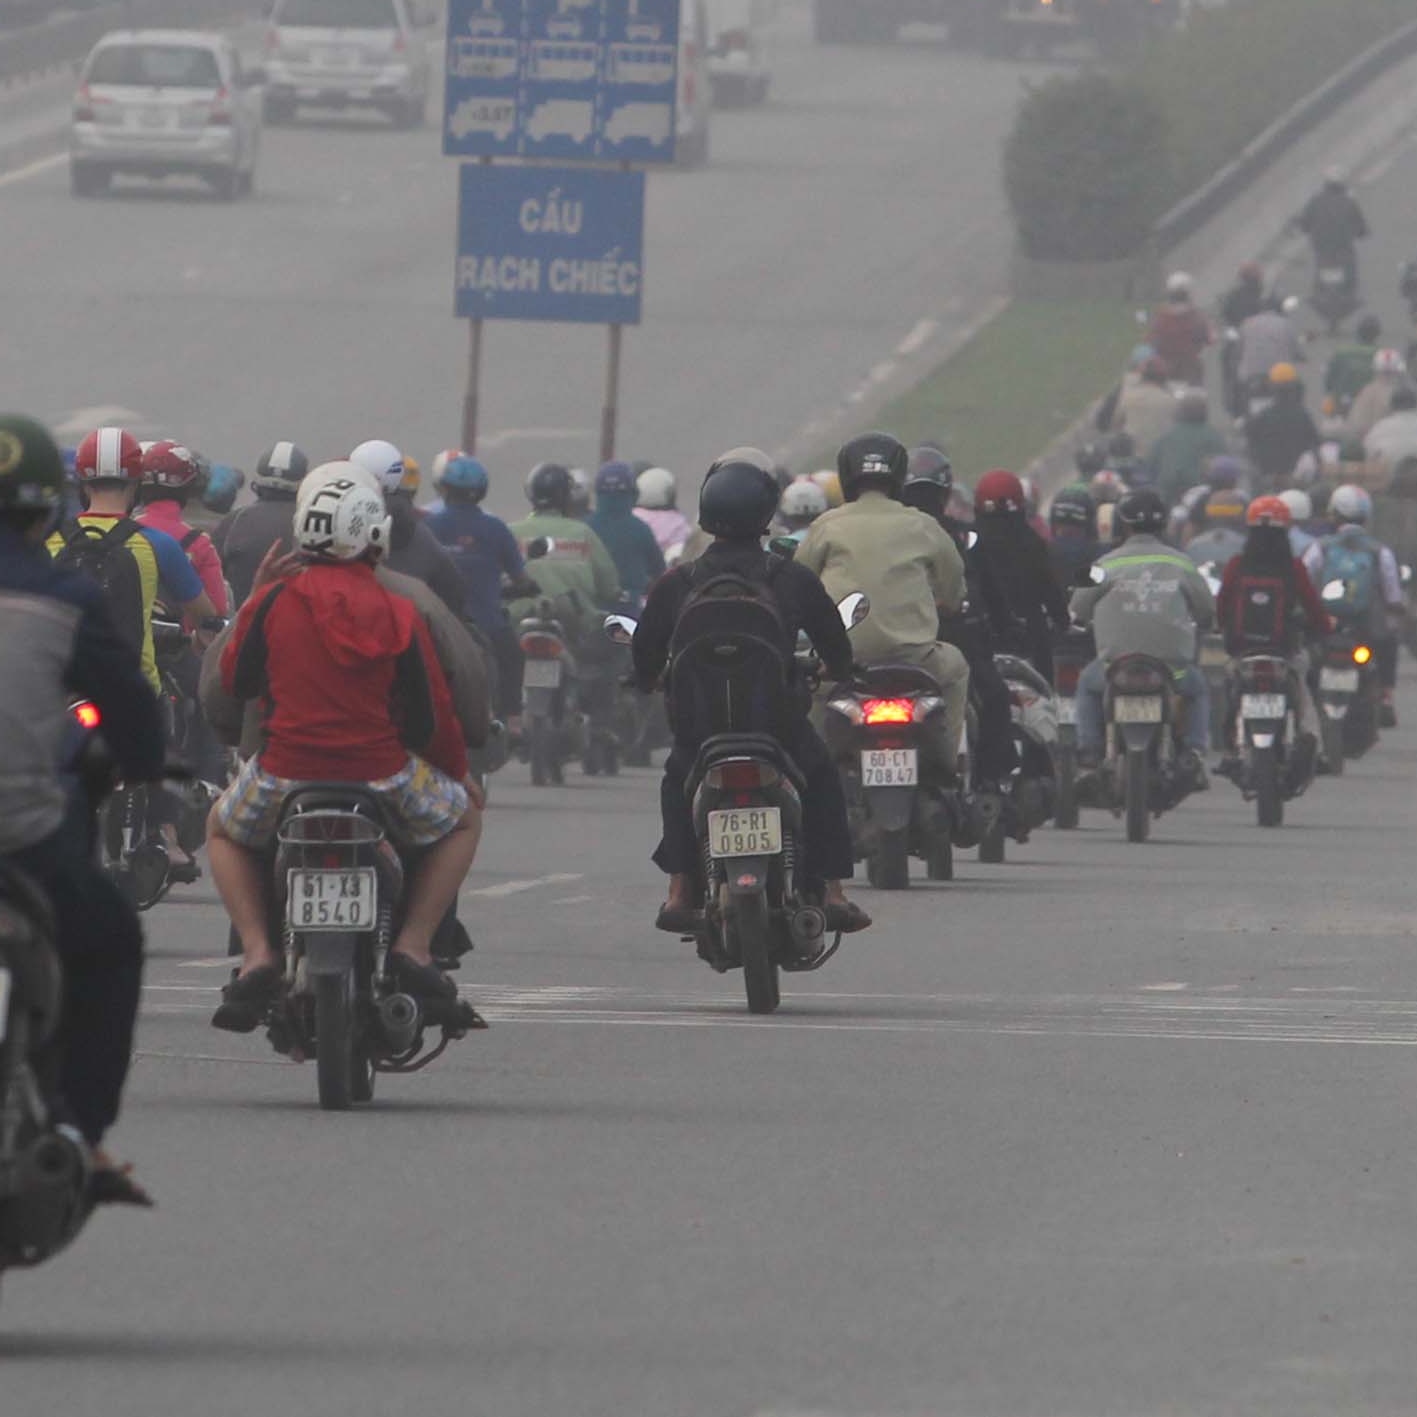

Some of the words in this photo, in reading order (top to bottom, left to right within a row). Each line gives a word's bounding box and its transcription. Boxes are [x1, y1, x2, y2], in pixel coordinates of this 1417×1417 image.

[719, 811, 768, 833] 76-R1
[720, 831, 771, 854] 0905
[302, 900, 361, 924] 8540
